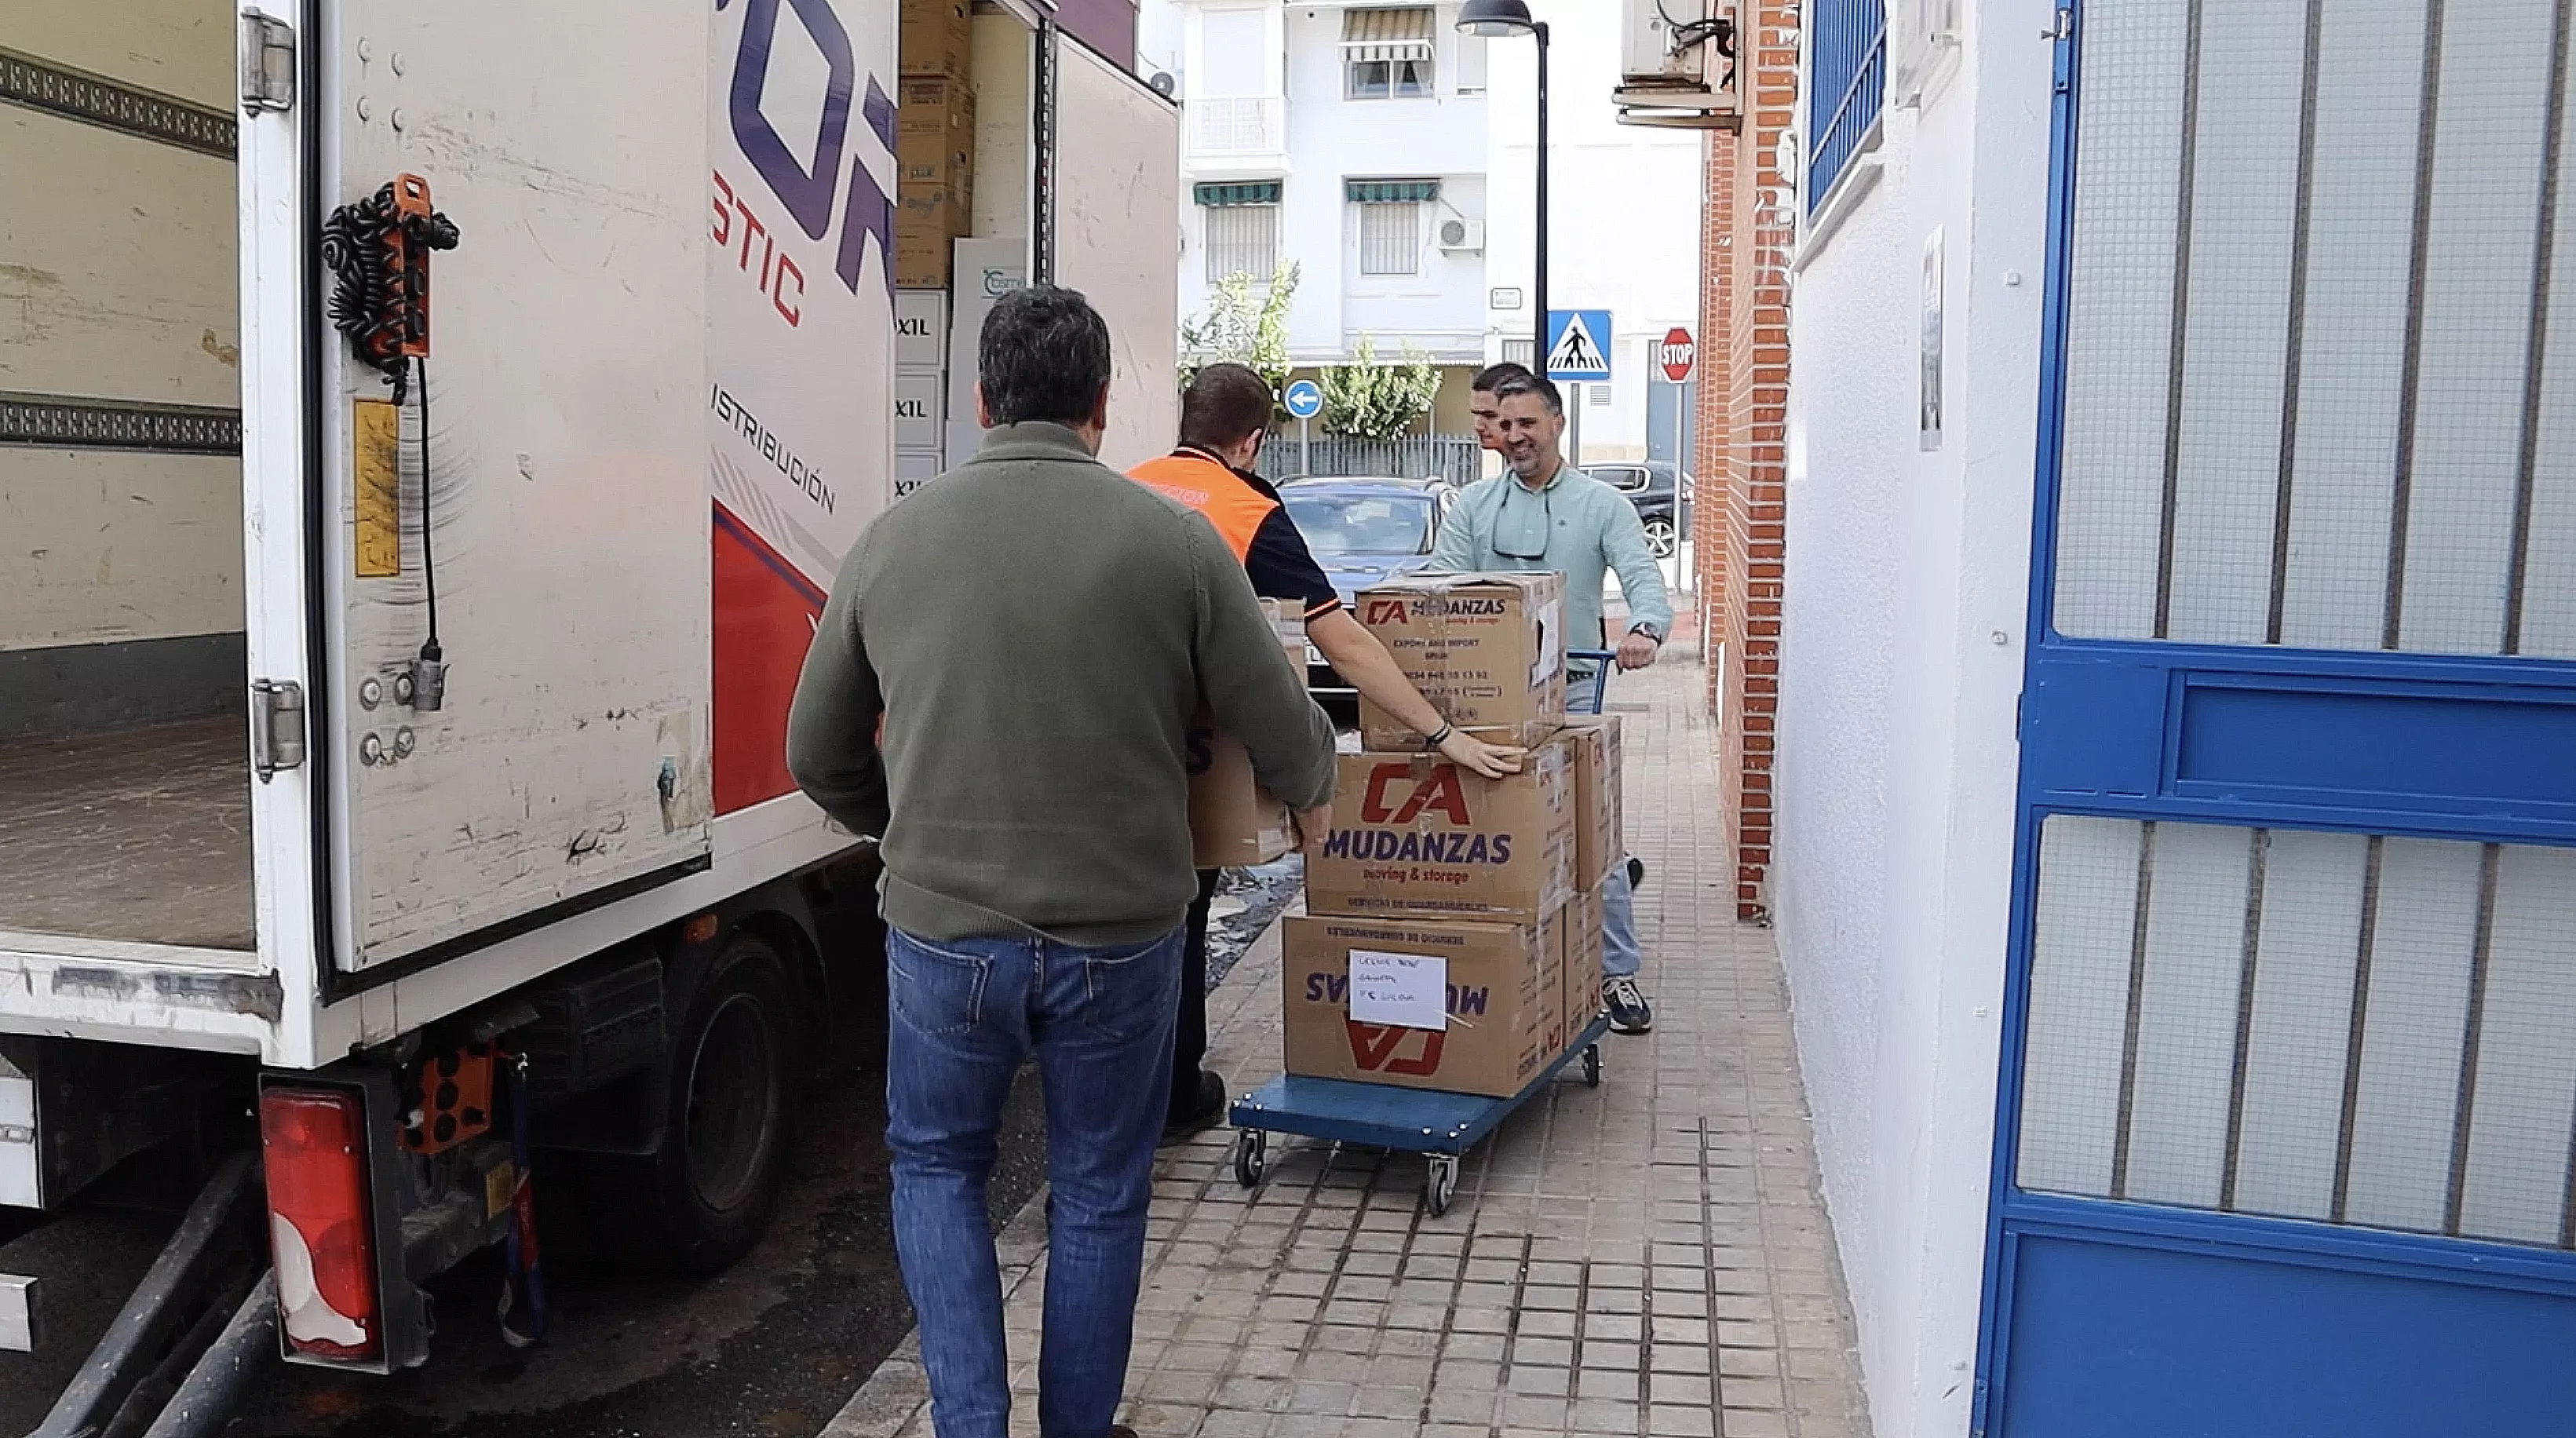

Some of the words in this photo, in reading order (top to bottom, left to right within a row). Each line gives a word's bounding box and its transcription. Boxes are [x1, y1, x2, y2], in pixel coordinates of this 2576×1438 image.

[1662, 344, 1693, 365] STOP
[711, 382, 835, 515] ISTRIBUCIÓN
[1367, 600, 1408, 625] CA
[1363, 762, 1471, 825] CA
[1323, 829, 1512, 863] MUDANZAS
[1364, 865, 1407, 882] moving
[1410, 867, 1419, 881] &
[1423, 868, 1469, 885] storage
[1345, 1011, 1448, 1074] CA
